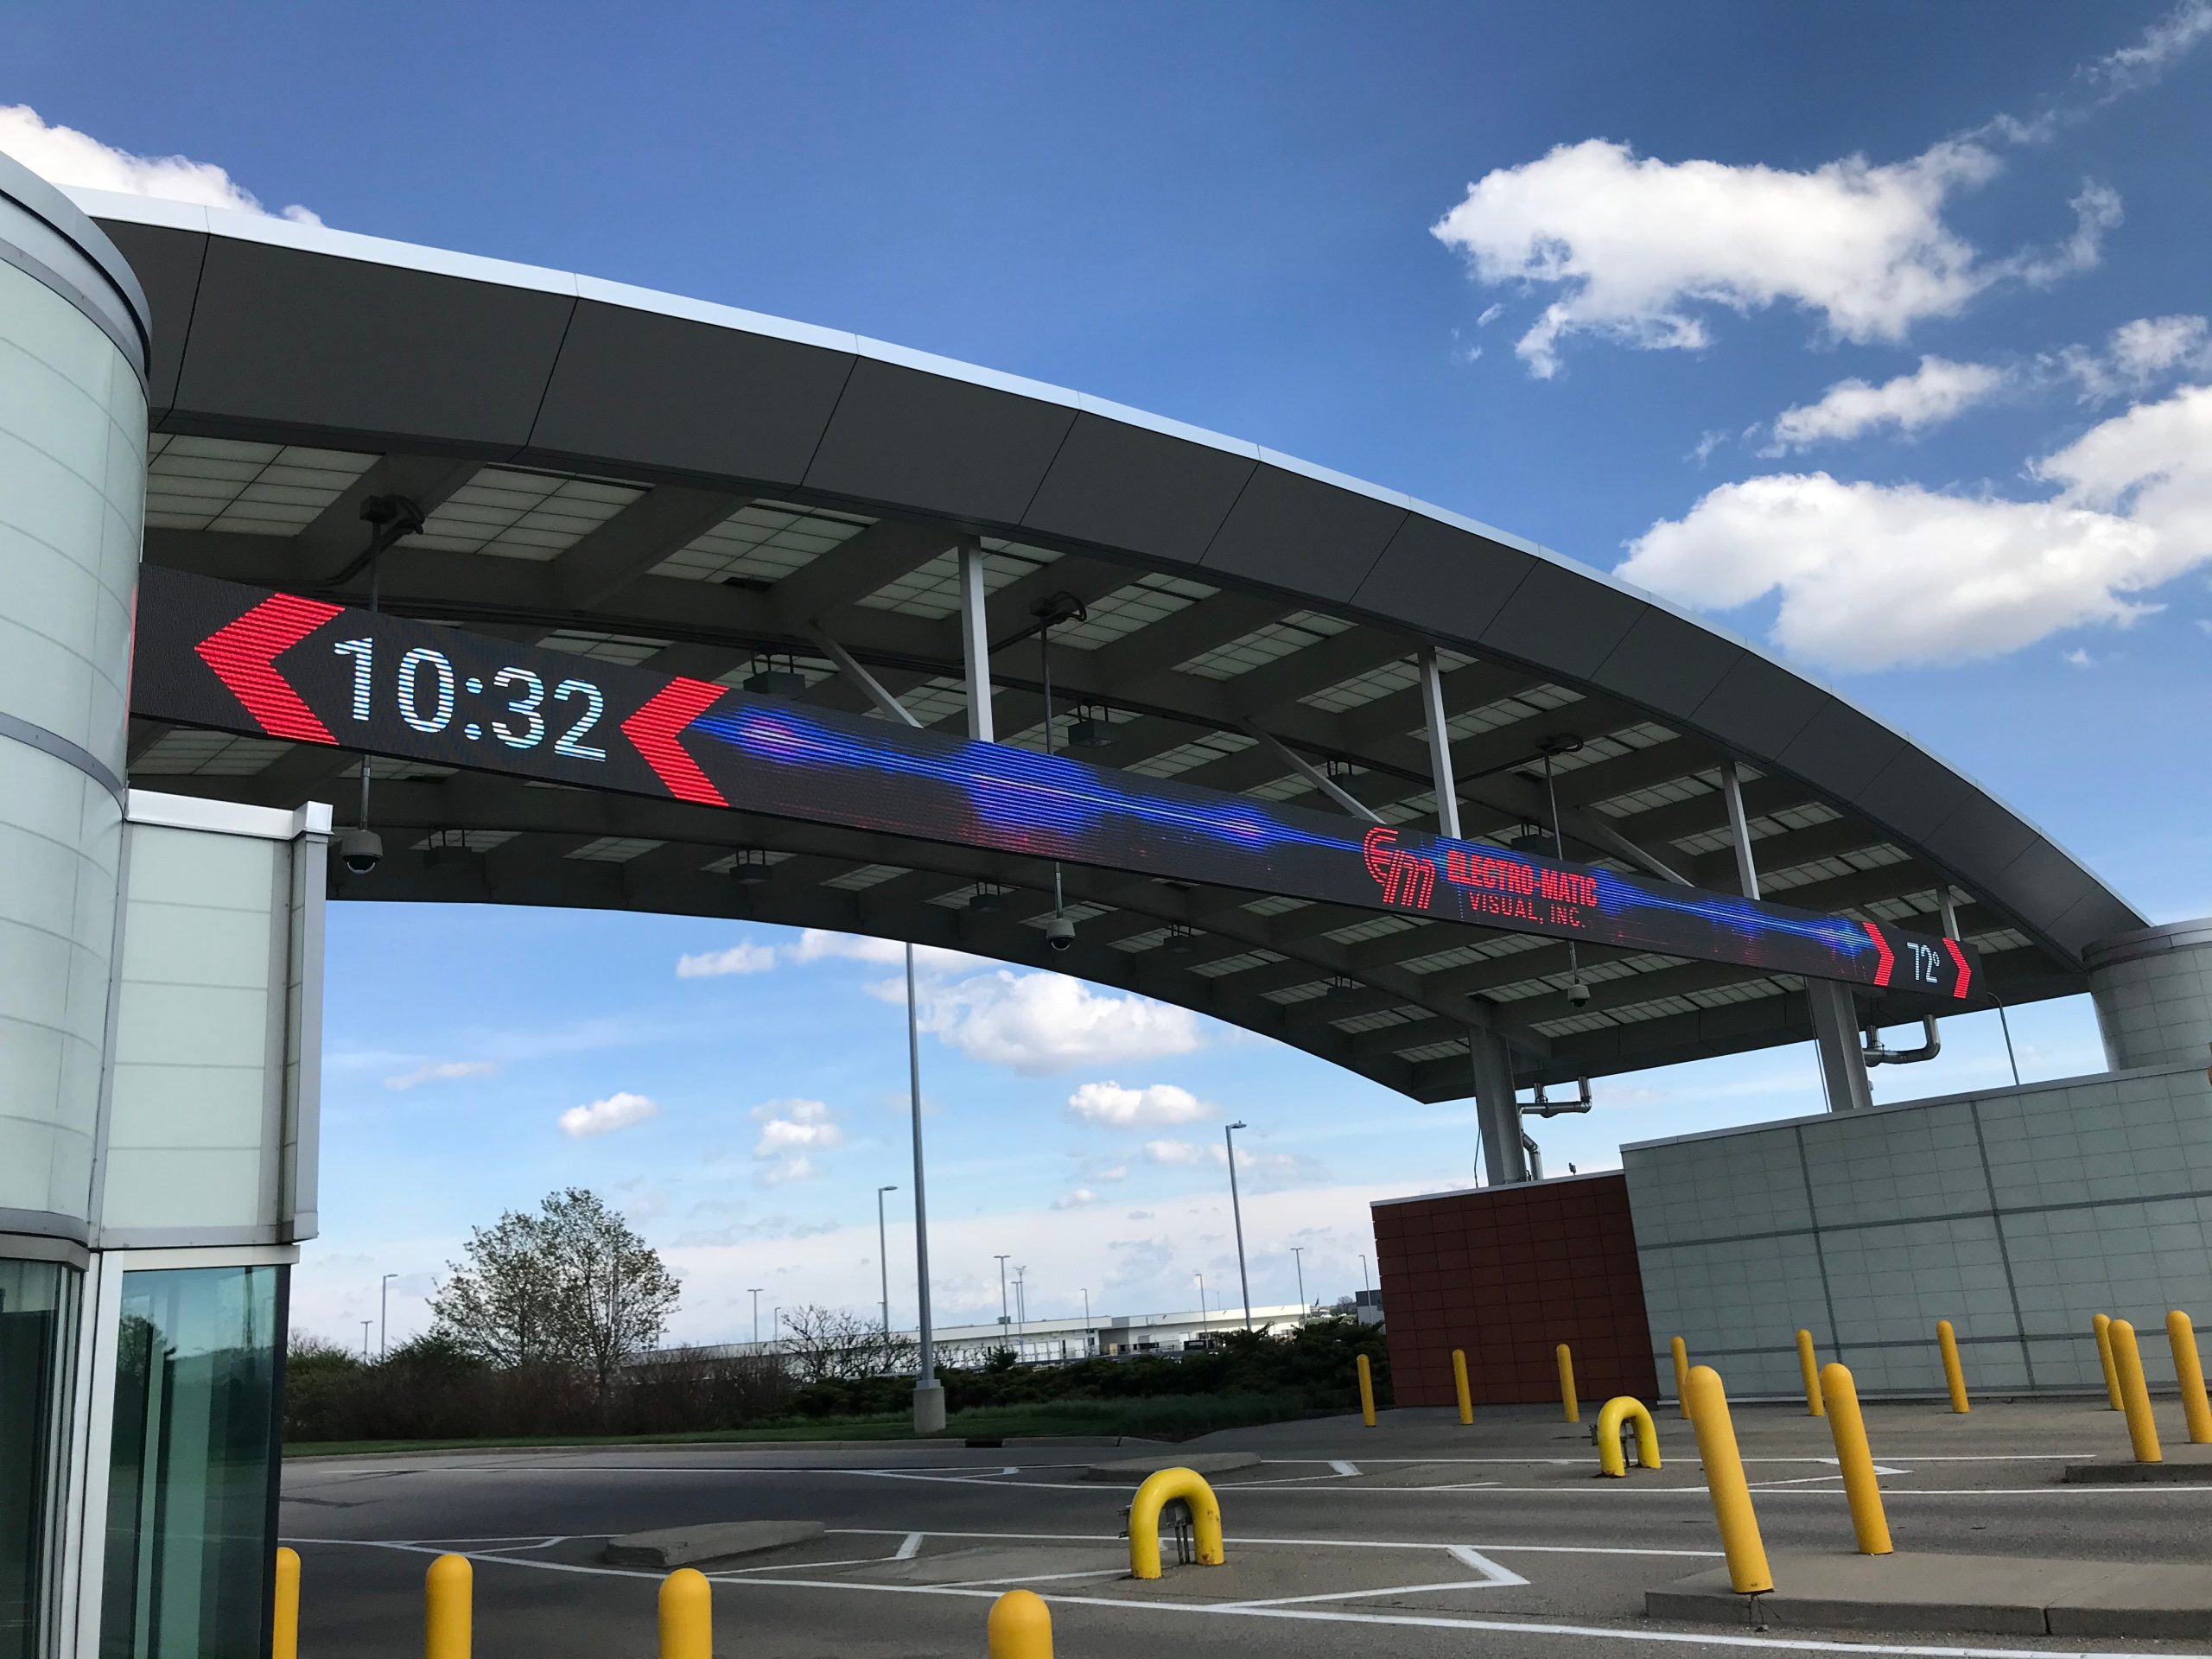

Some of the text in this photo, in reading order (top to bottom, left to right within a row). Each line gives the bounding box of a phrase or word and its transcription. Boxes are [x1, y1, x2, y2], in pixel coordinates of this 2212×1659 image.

[334, 637, 607, 761] 10:32
[1446, 849, 1599, 907] ELECTRO-MATIC
[1469, 891, 1586, 928] VISUAL, INC.
